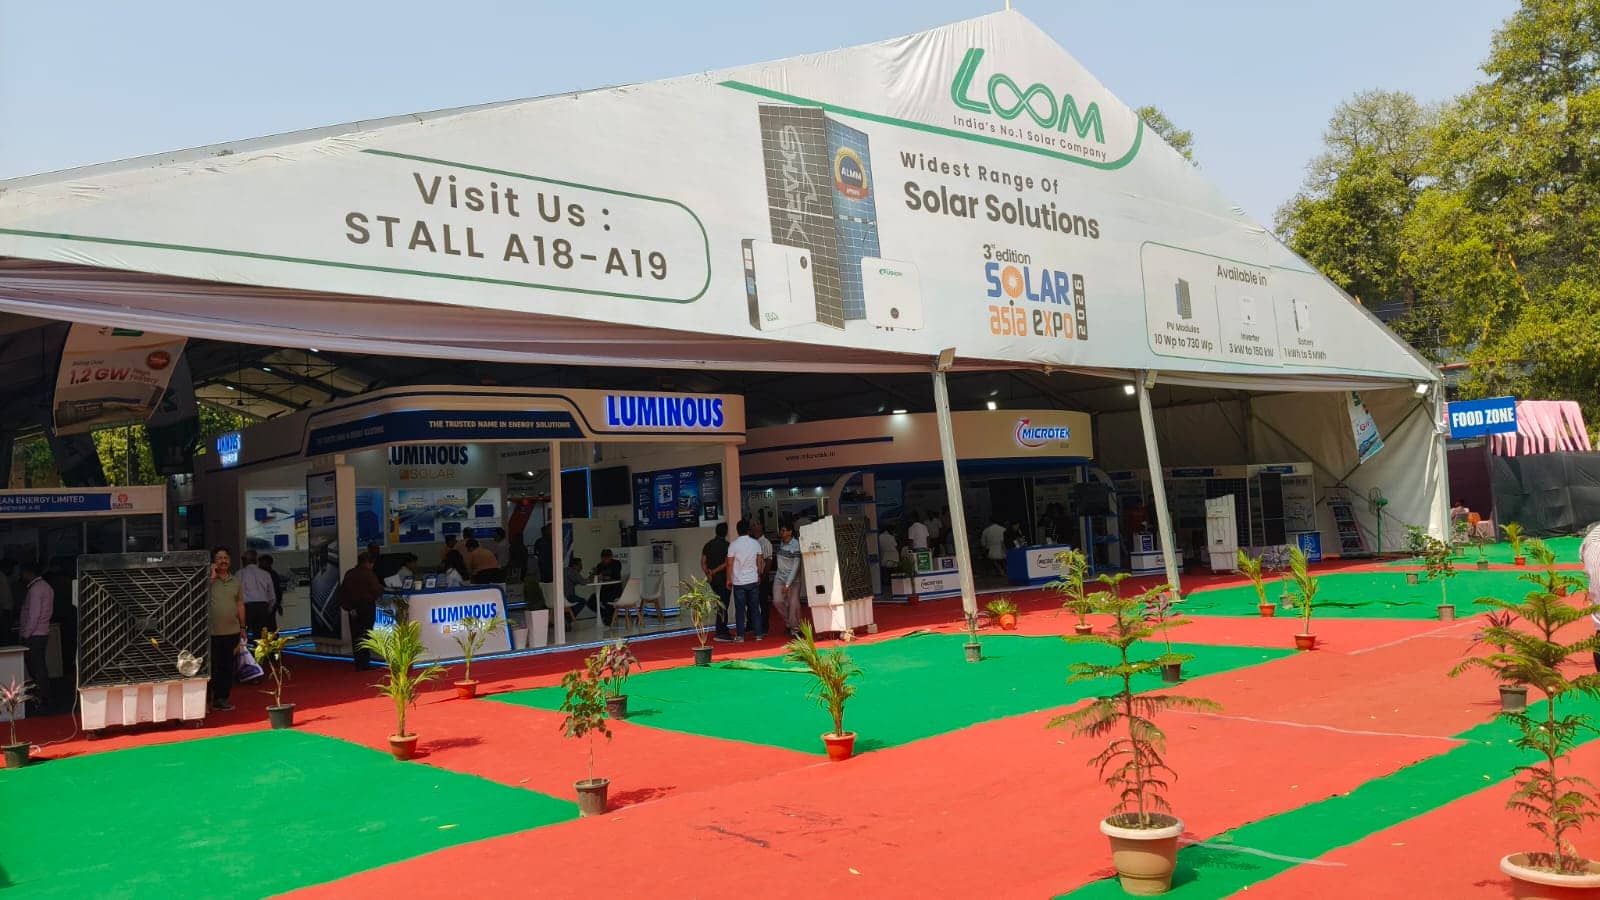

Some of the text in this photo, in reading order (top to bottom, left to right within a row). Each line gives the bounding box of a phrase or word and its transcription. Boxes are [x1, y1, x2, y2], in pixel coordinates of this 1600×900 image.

[951, 47, 1106, 145] LOOM
[953, 114, 1107, 162] India's No.1 Solar Company
[900, 151, 1059, 195] Widest Range Of
[413, 172, 521, 218] Visit
[537, 192, 586, 227] Us
[903, 180, 1100, 239] Solar Solutions
[345, 211, 668, 281] STALL A18-A19
[995, 248, 1032, 265] edition
[985, 262, 1071, 306] SOLAR
[1217, 264, 1268, 286] Available in
[1074, 279, 1087, 336] 2026
[989, 299, 1074, 340] asia expo
[1155, 333, 1213, 351] 10 Wp to 730 Wp
[1245, 345, 1253, 356] to
[70, 368, 92, 385] 1.2
[95, 367, 129, 381] GW
[606, 395, 724, 429] LUMINOUS
[1452, 407, 1515, 428] FOOD ZONE
[445, 421, 476, 429] TRUSTED
[478, 421, 498, 429] NAME
[1022, 427, 1070, 439] MICROTEK
[388, 447, 469, 465] UMINOUS
[16, 496, 50, 505] ENERGY
[52, 495, 85, 504] LIMITED
[431, 602, 497, 624] LUMINOUS
